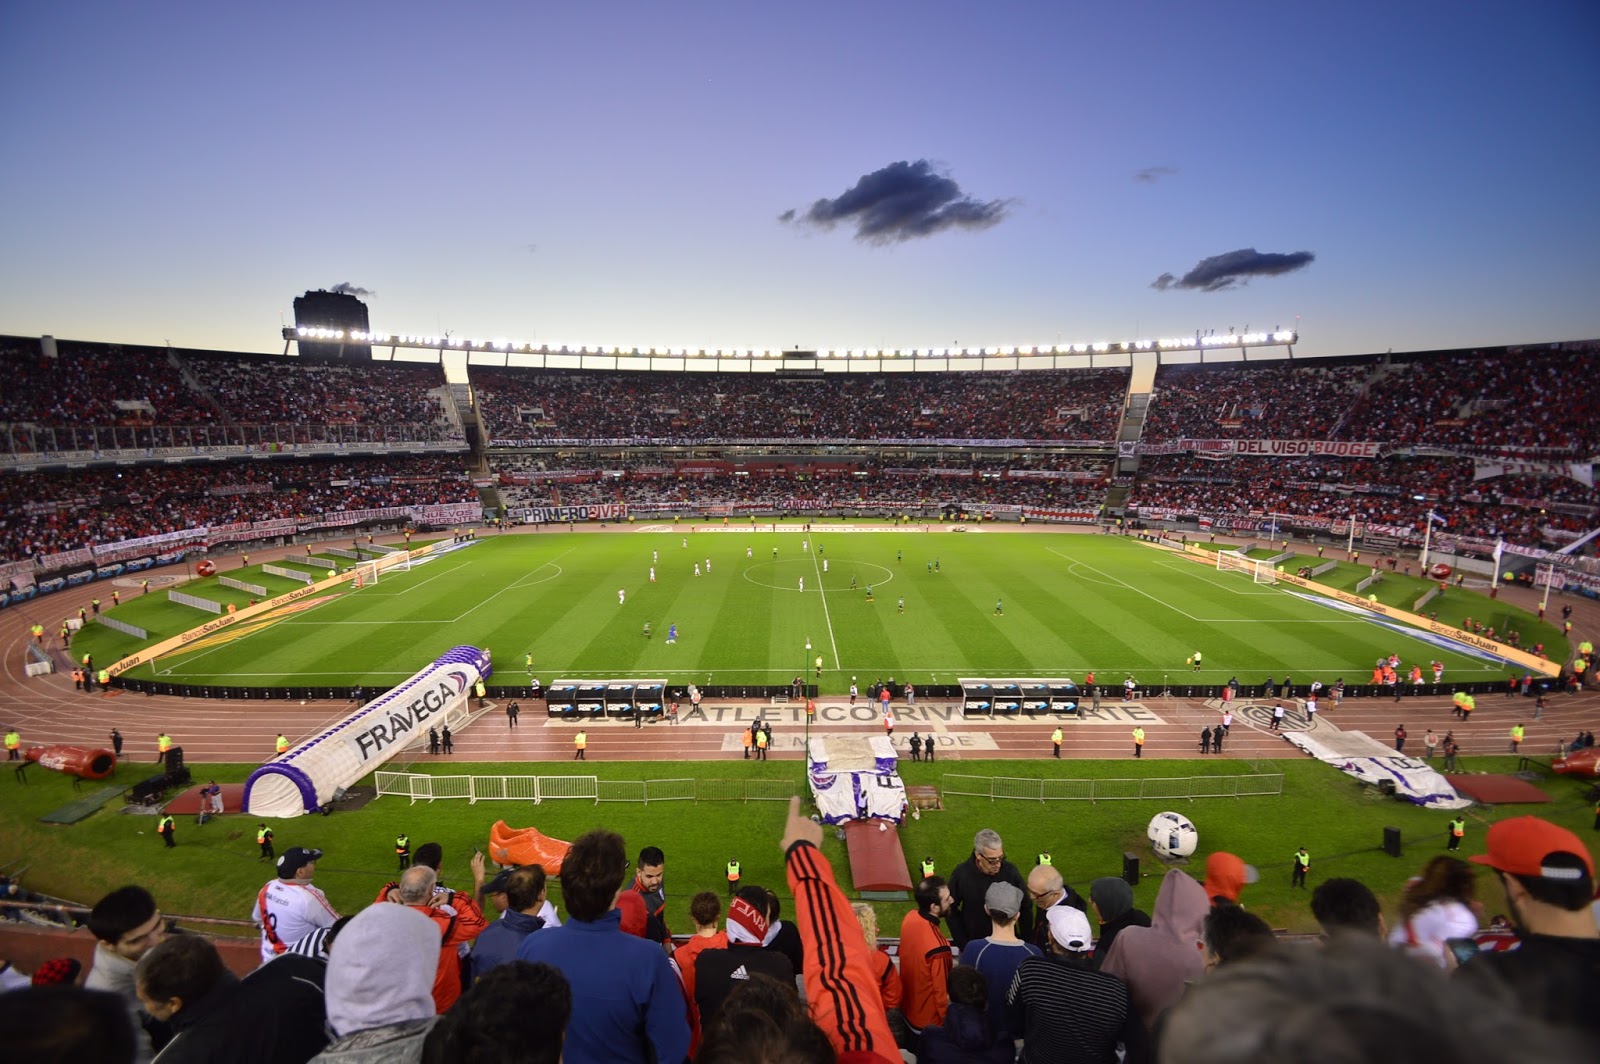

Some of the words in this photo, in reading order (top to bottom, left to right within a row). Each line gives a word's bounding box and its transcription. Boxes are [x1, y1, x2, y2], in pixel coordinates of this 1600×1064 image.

[1236, 441, 1268, 454] DEL
[1271, 441, 1309, 454] VISO
[1313, 441, 1376, 456] BUDGE
[1502, 464, 1573, 478] PILAR
[413, 515, 482, 525] DIRIGENTES
[421, 510, 473, 519] NUEVOS
[233, 531, 257, 541] ARIEL
[258, 526, 296, 537] ORTEGA
[1367, 523, 1402, 536] OZZY
[270, 586, 316, 607] BancoSanJuan
[1336, 590, 1387, 614] BancoSanJuan
[181, 615, 235, 643] BancoSanJuan
[1430, 621, 1498, 653] BancoSanJuan
[354, 682, 456, 761] FRÁVEGA
